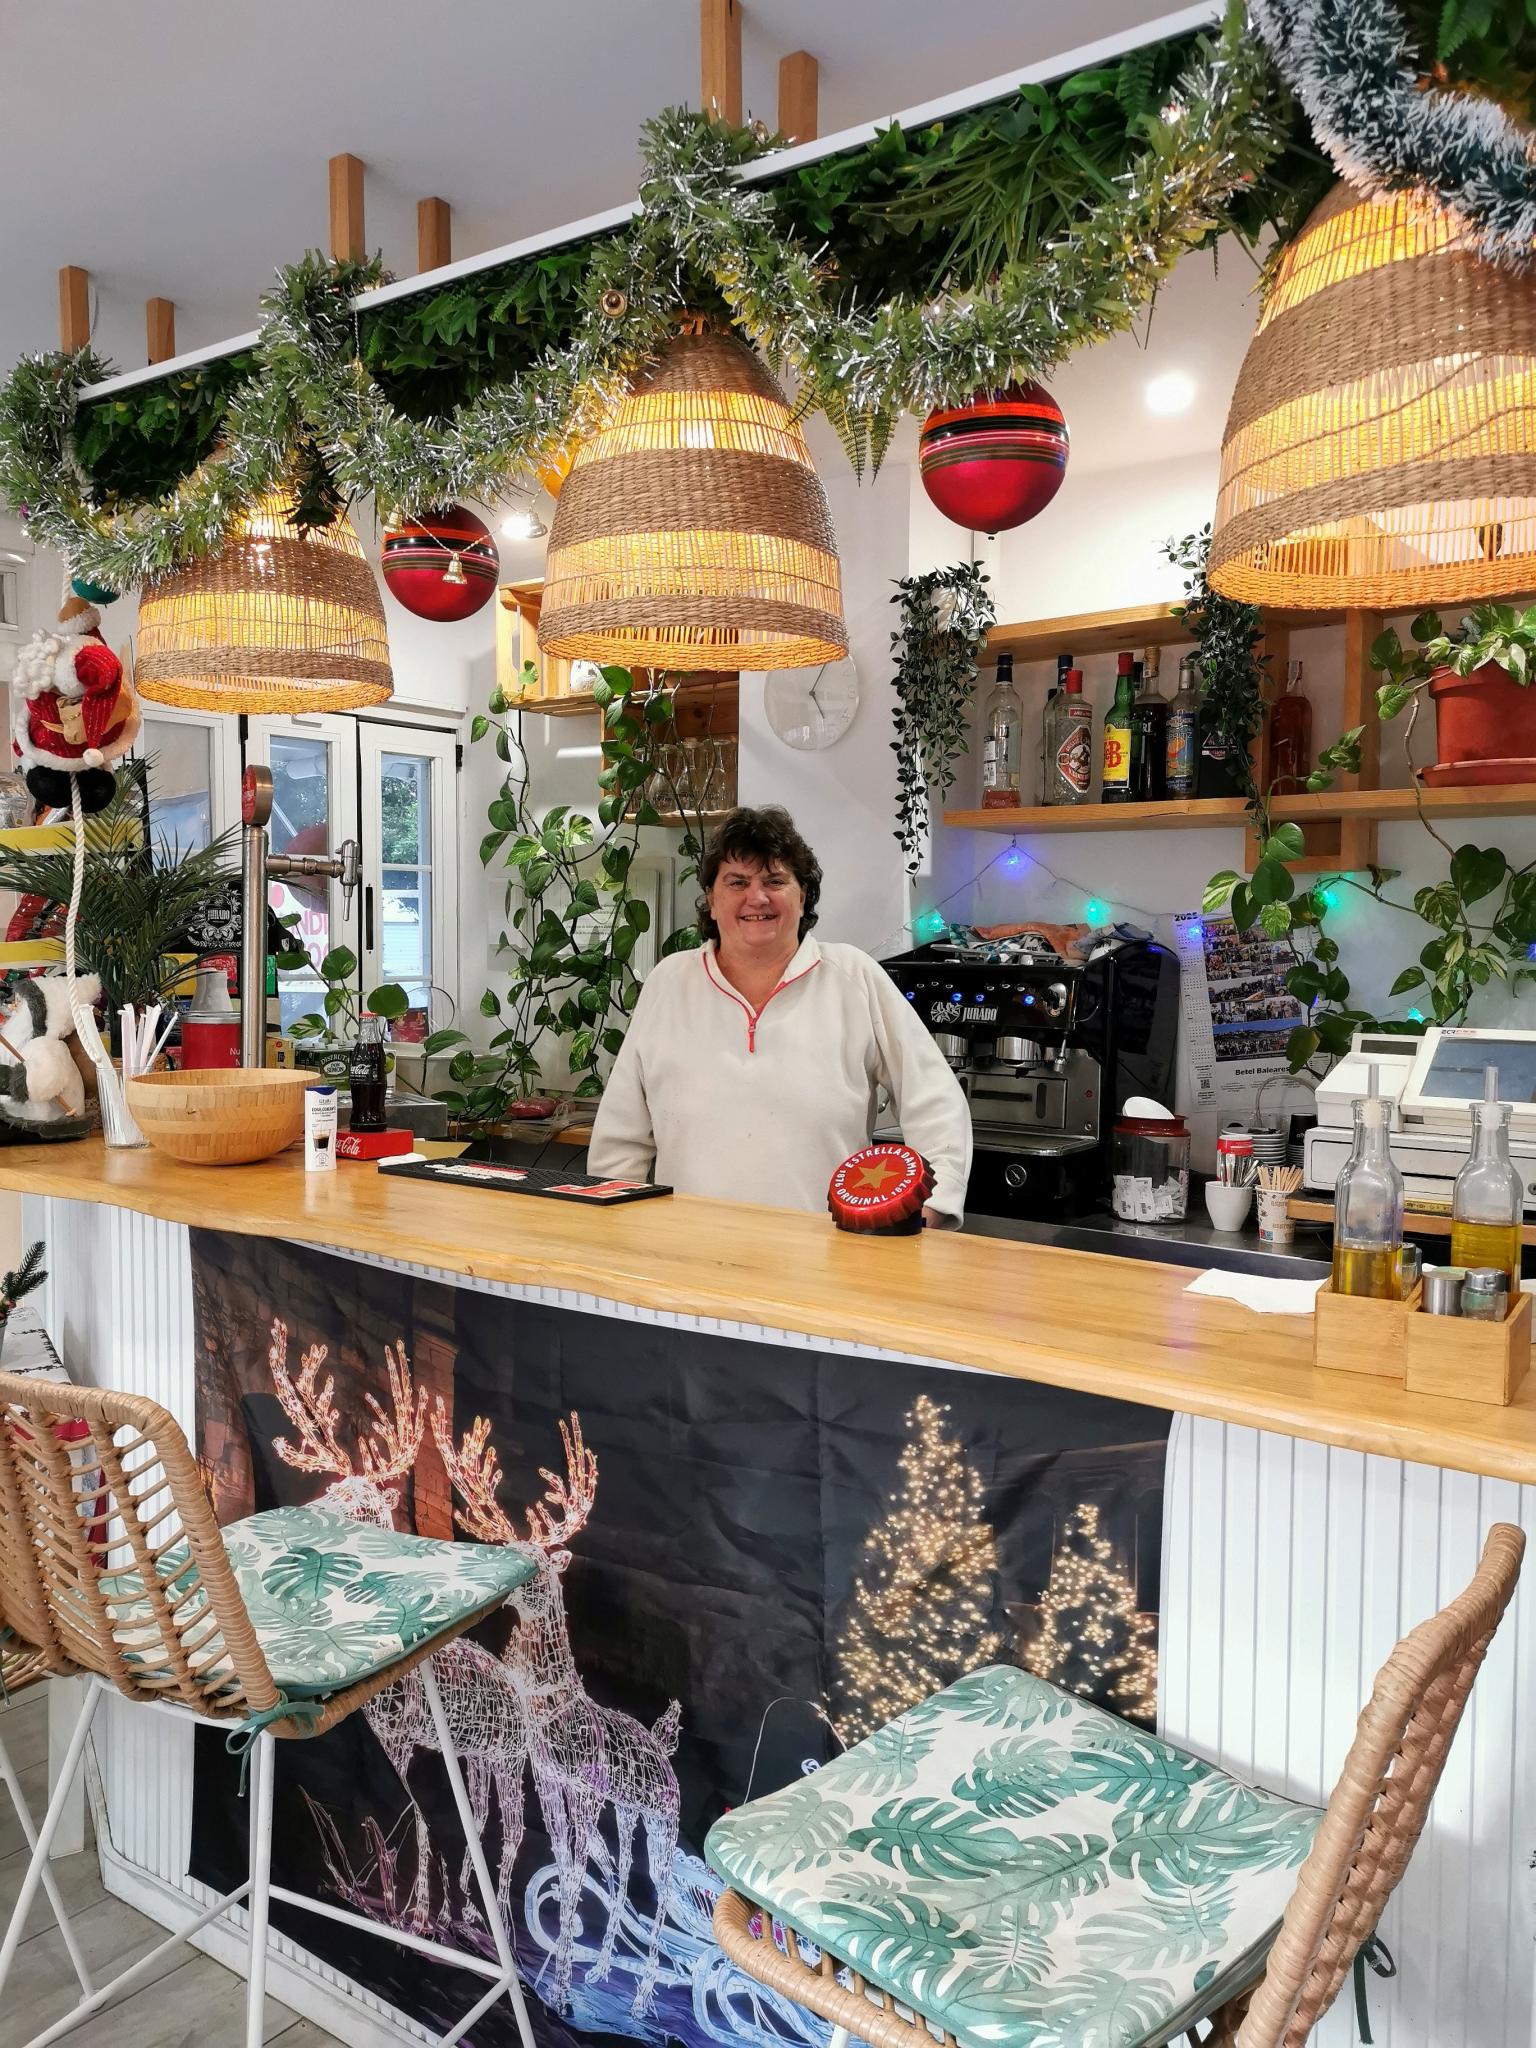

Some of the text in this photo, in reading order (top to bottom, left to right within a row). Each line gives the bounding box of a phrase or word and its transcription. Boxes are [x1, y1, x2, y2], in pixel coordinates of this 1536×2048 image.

[1174, 911, 1199, 921] 2025
[962, 1006, 998, 1022] JURADO
[320, 1053, 350, 1065] DISFRUTA
[1235, 1065, 1290, 1076] Betel Baleares
[845, 1146, 917, 1176] ESTRELLA DAMM
[836, 1188, 889, 1205] ORIGINAL
